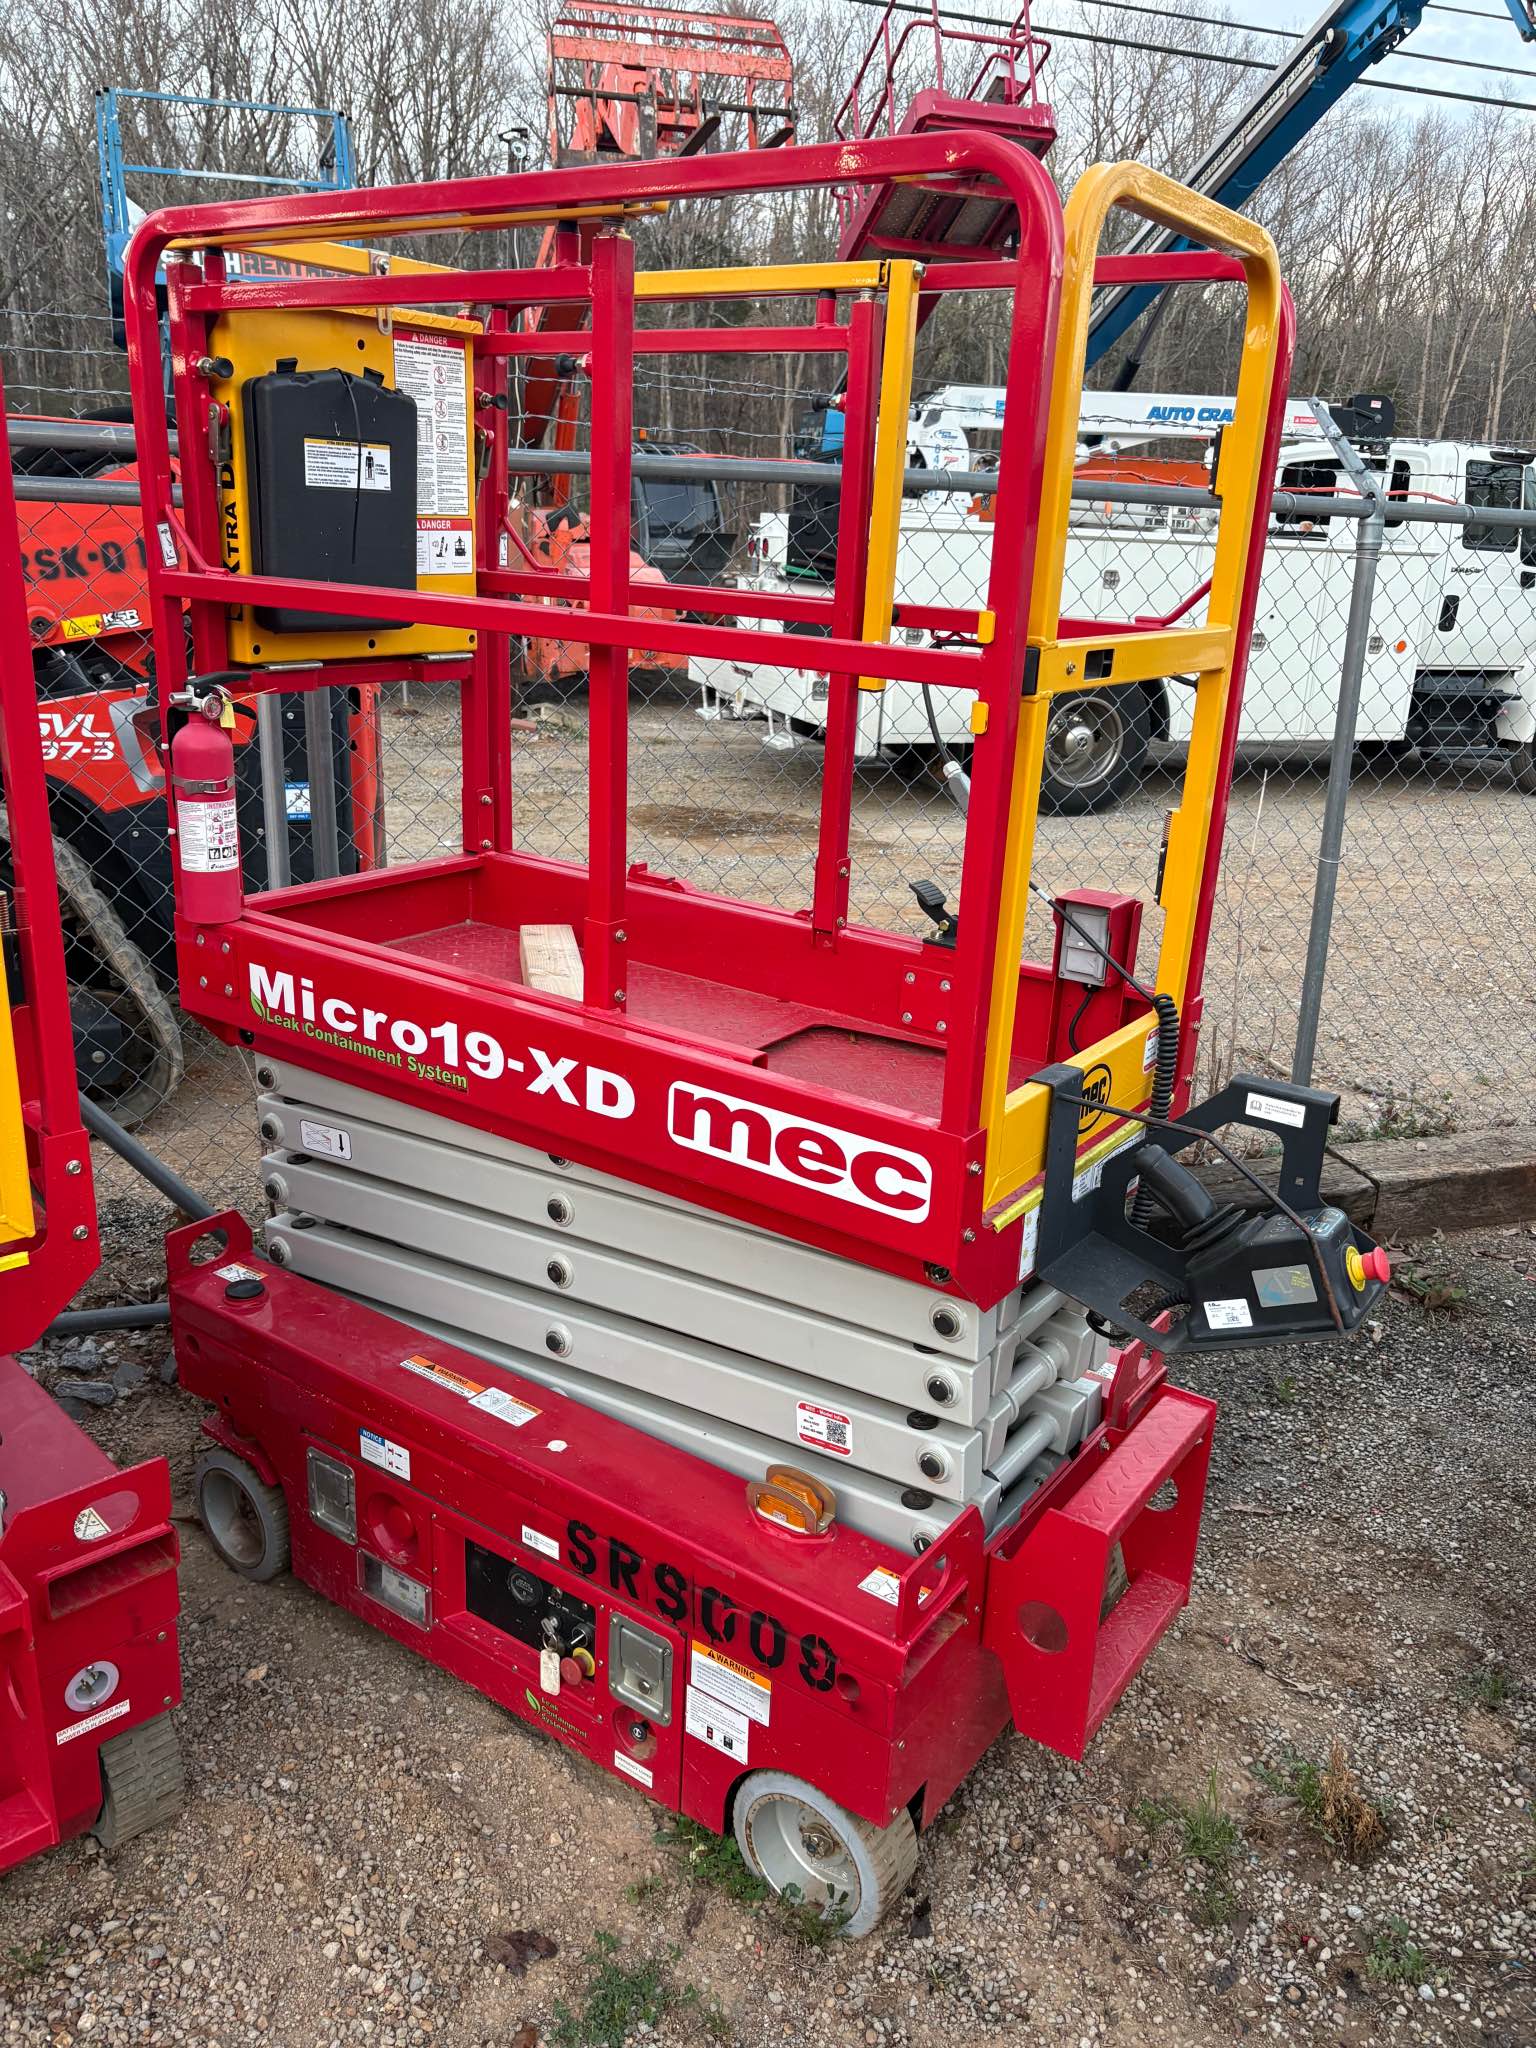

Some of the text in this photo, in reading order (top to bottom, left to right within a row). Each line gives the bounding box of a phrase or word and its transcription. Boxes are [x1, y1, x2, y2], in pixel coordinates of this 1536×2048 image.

[419, 333, 448, 346] DANGER
[1147, 406, 1236, 422] AUTO CRA
[421, 520, 451, 529] DANGER
[248, 962, 637, 1120] Micro19-XD
[266, 1007, 468, 1089] Leak Containment System
[672, 1087, 928, 1211] mec
[362, 1430, 382, 1444] NOTICE
[716, 1652, 756, 1680] WARNING
[541, 1696, 559, 1711] Leak
[58, 1701, 129, 1738] BATTERY CHARGER AND
[58, 1730, 81, 1744] POWER
[90, 1711, 123, 1729] PLATFORM
[541, 1705, 588, 1739] Containment
